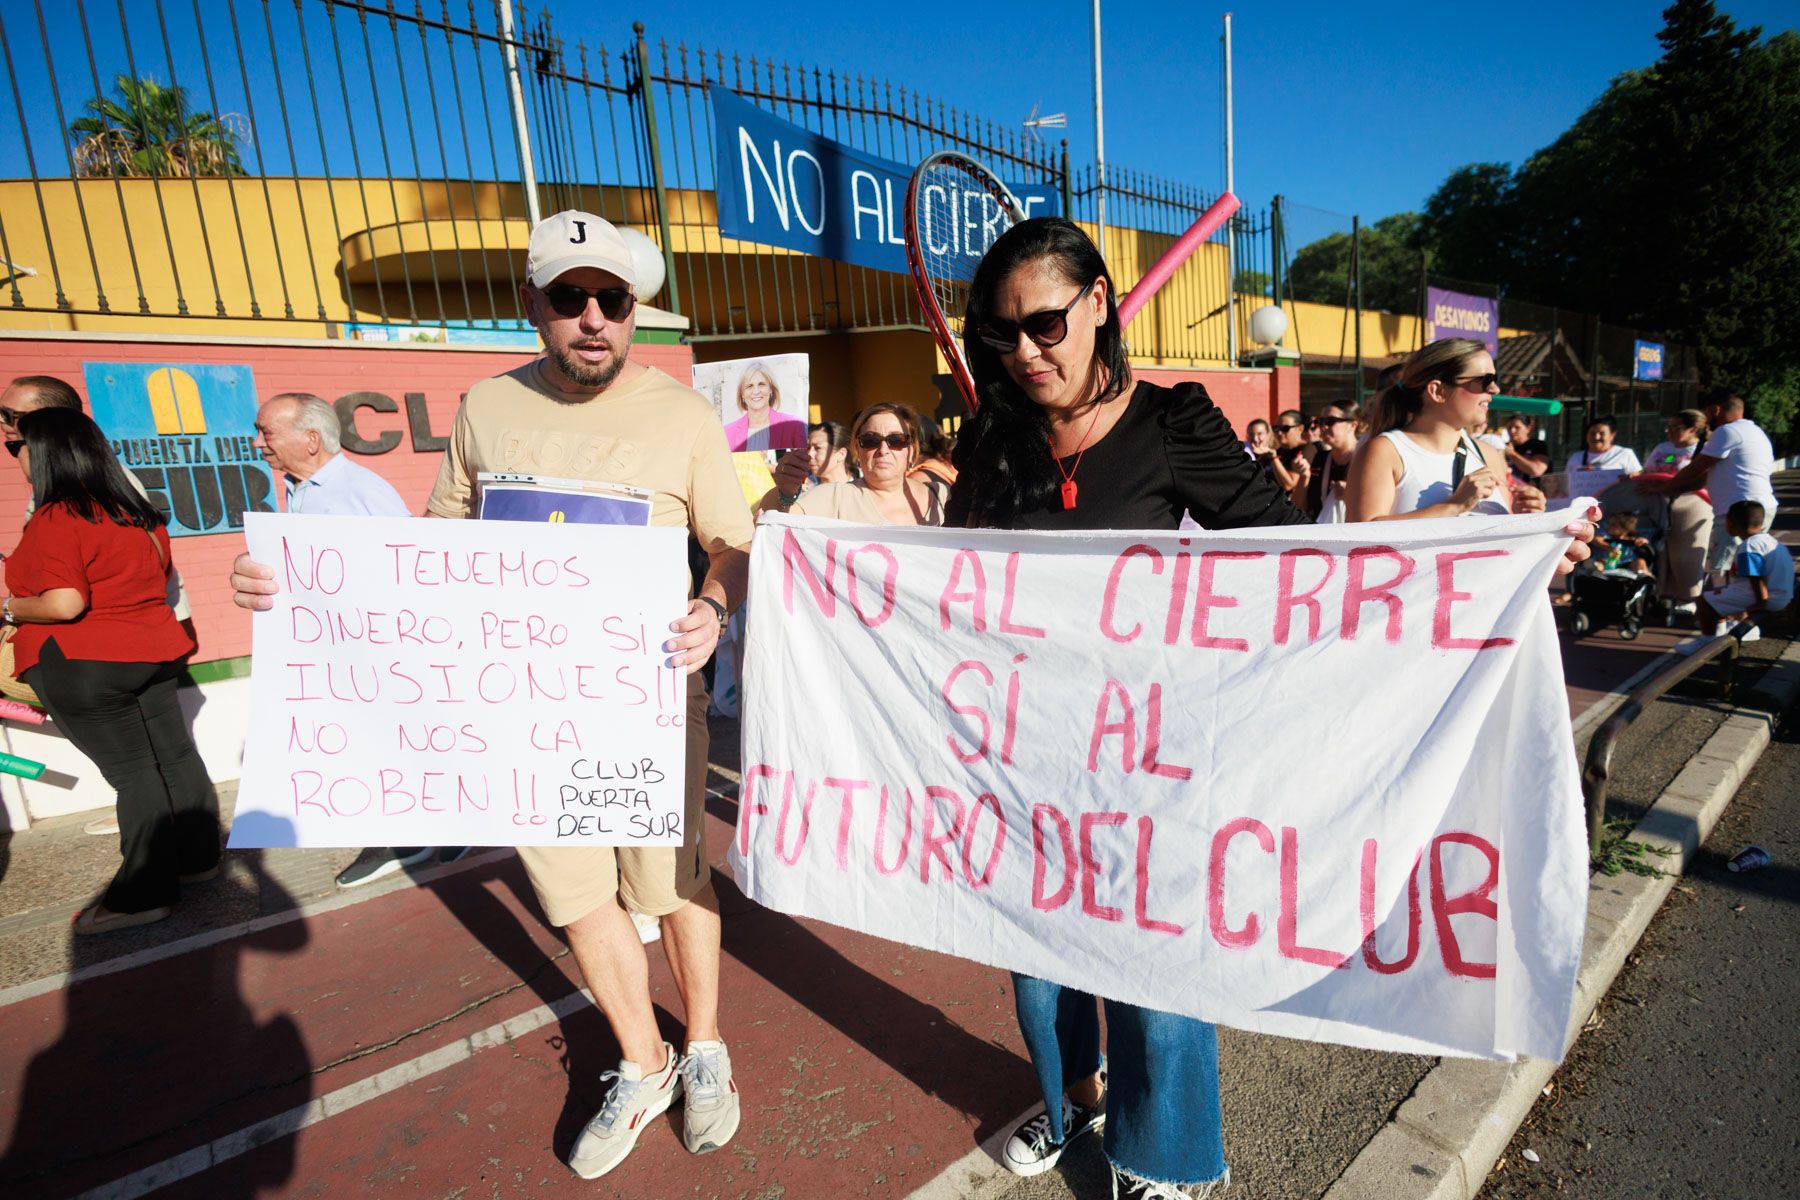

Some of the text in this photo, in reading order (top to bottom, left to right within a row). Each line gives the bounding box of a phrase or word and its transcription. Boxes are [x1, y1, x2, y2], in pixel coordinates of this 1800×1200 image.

[738, 126, 826, 236] NO
[851, 170, 906, 245] AL
[569, 220, 587, 244] J
[496, 428, 641, 477] BOSS
[282, 535, 590, 595] NO TENEMOS
[782, 527, 899, 629] NO
[939, 547, 1046, 639] AL
[291, 605, 463, 650] DINERO,
[481, 611, 568, 650] PERO
[288, 716, 582, 755] NO NOS LA
[1087, 678, 1193, 780] AL
[571, 757, 665, 784] CLUB
[559, 784, 651, 811] PUERTA
[557, 811, 682, 839] DEL SUR
[740, 763, 1500, 980] FUTURO DEL CLUB
